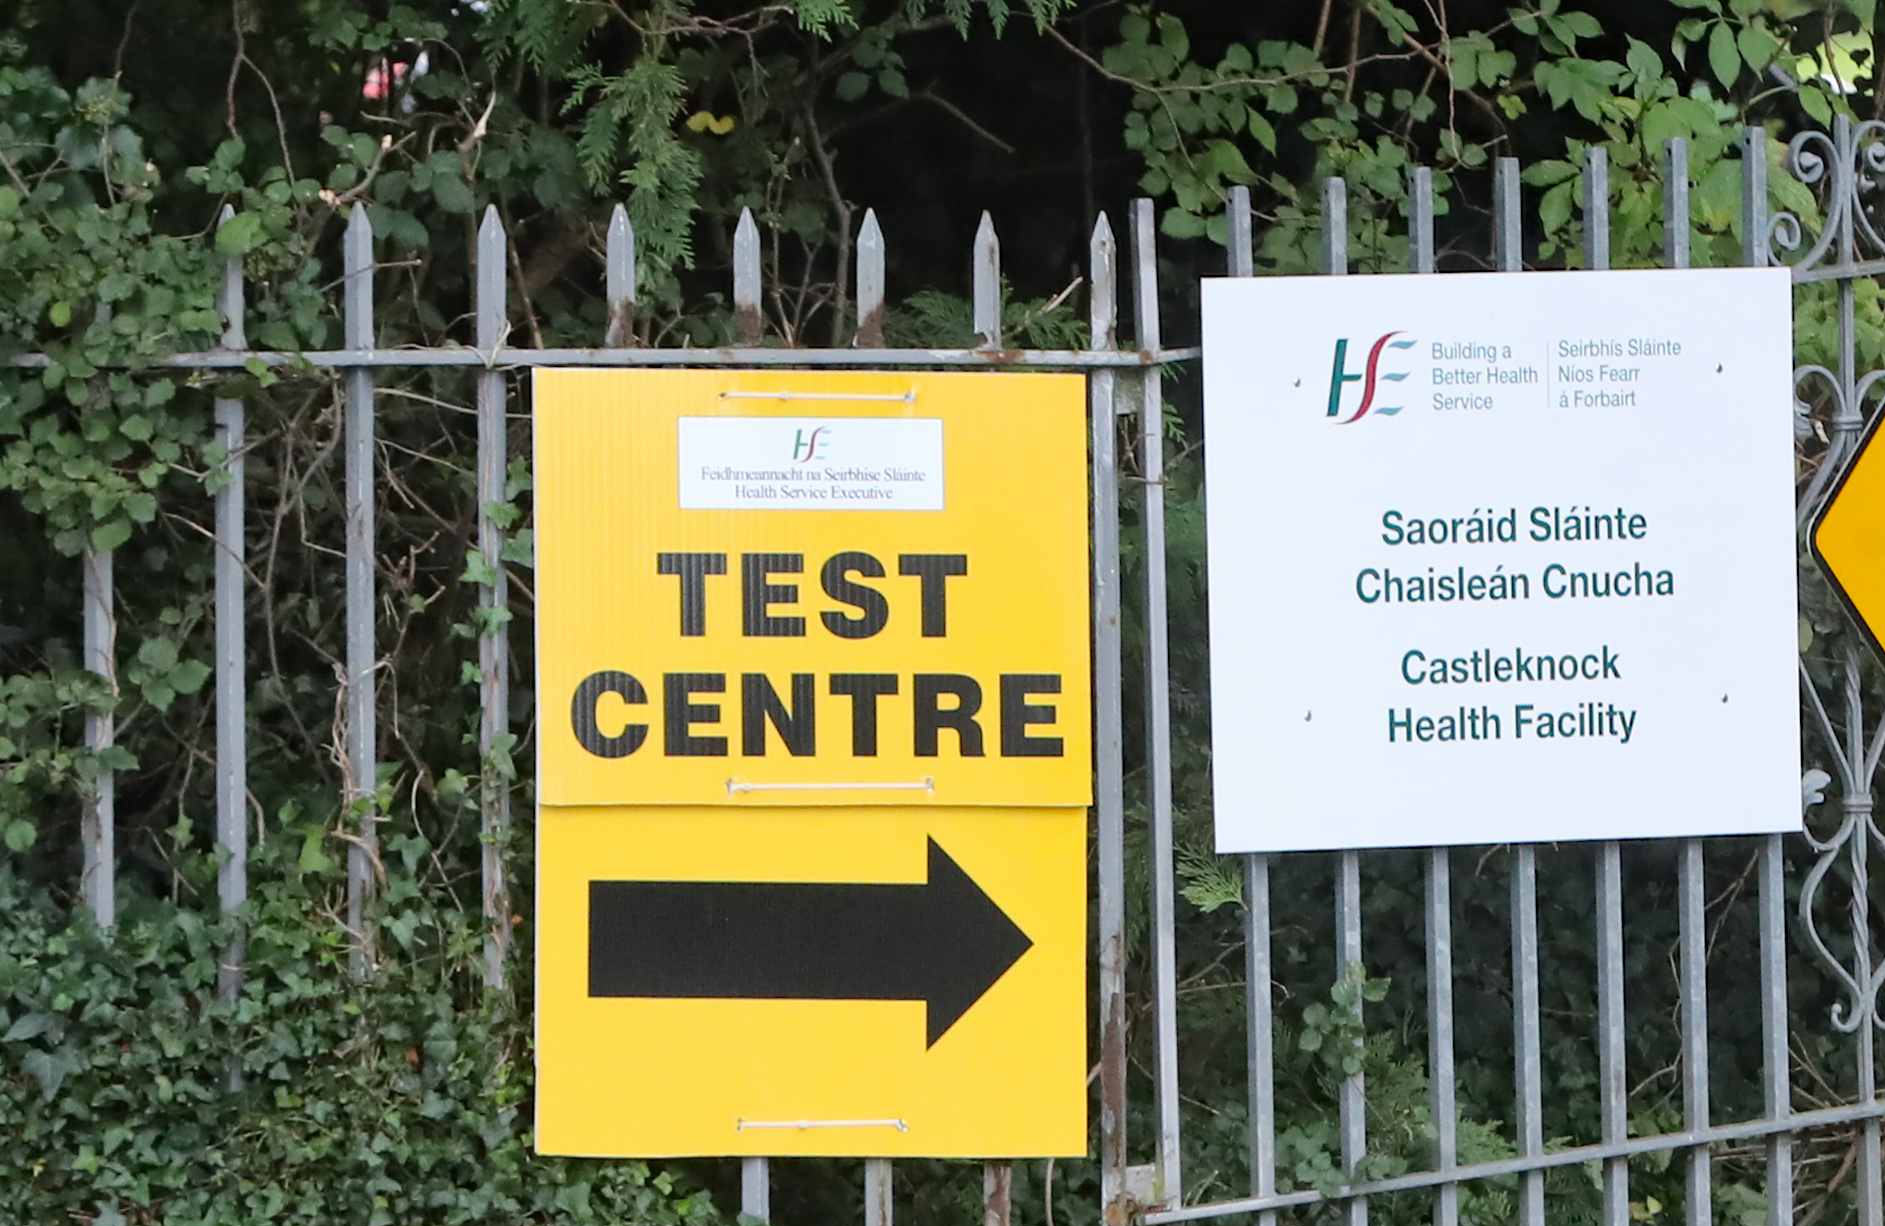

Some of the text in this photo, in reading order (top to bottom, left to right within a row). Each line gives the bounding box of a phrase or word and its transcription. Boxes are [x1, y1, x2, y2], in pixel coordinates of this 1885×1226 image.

[1431, 341, 1512, 362] Building a
[1558, 338, 1682, 357] Seirbhís Sláinte
[1432, 365, 1538, 385] Better Health
[1558, 365, 1641, 383] Níos Fearr
[1432, 392, 1493, 410] Service
[1559, 390, 1637, 408] á Forbairt
[701, 466, 803, 482] Feidhmeannacht
[806, 471, 821, 482] na
[734, 485, 893, 499] Health Service Executive
[1381, 506, 1648, 545] Saoráid Sláinte
[1356, 562, 1675, 603] Chaisleán Cnucha
[657, 552, 968, 639] TEST
[1401, 644, 1621, 684] Castleknock
[570, 670, 1064, 759] CENTRE
[1388, 703, 1637, 743] Health Facility
